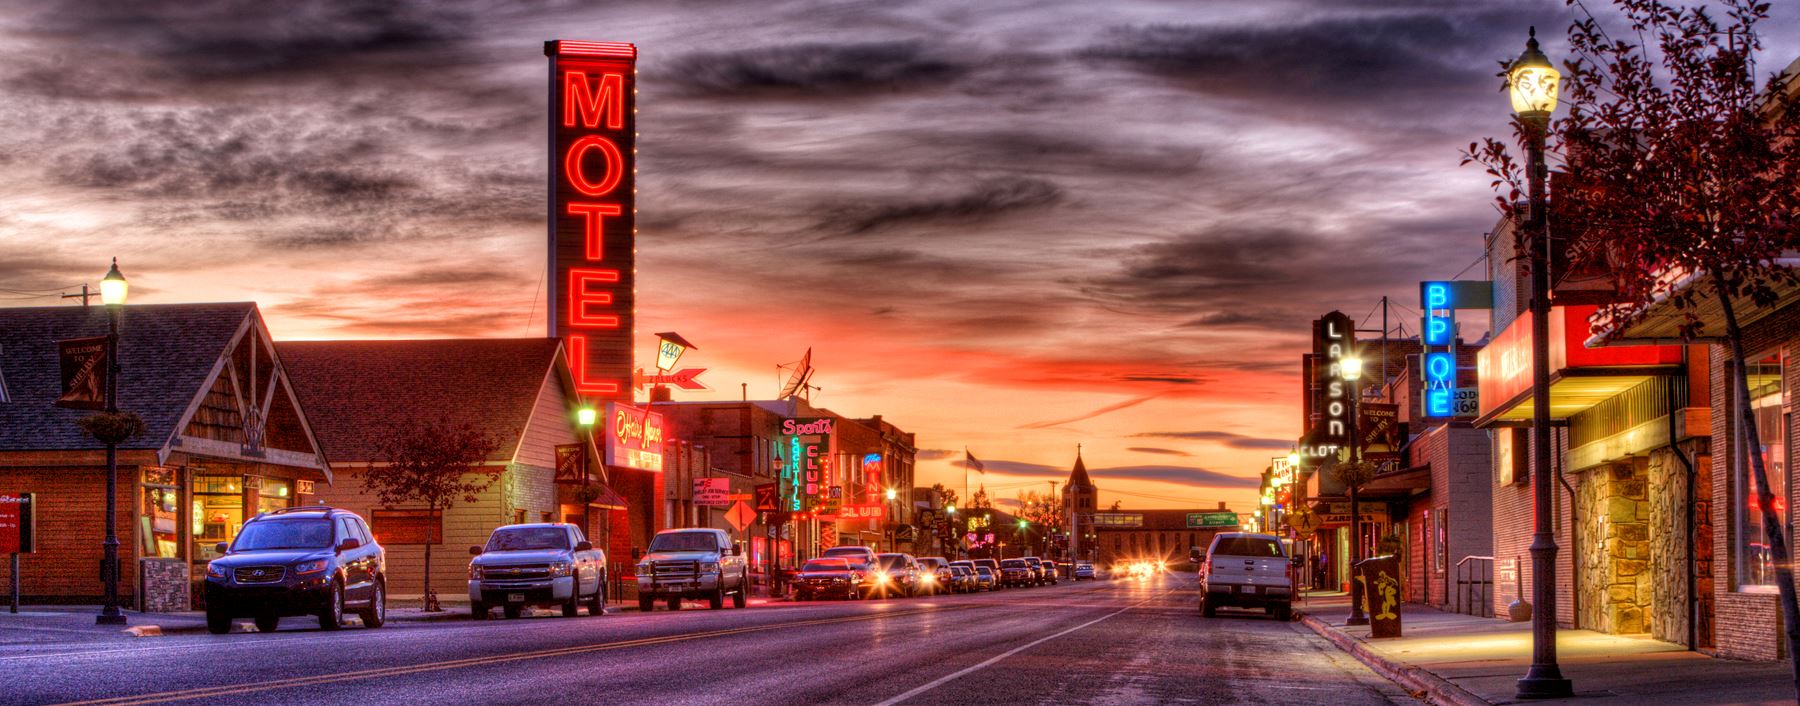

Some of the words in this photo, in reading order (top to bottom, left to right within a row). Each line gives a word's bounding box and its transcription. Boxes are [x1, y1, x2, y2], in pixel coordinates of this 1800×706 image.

[565, 71, 622, 393] MOTEL
[65, 344, 103, 354] WELCOME
[1429, 286, 1450, 413] BPOE
[782, 419, 832, 435] Sports
[791, 436, 801, 512] COCKTAILS
[806, 445, 819, 495] CLUB
[867, 462, 880, 502] MINT
[841, 506, 882, 518] CLUB
